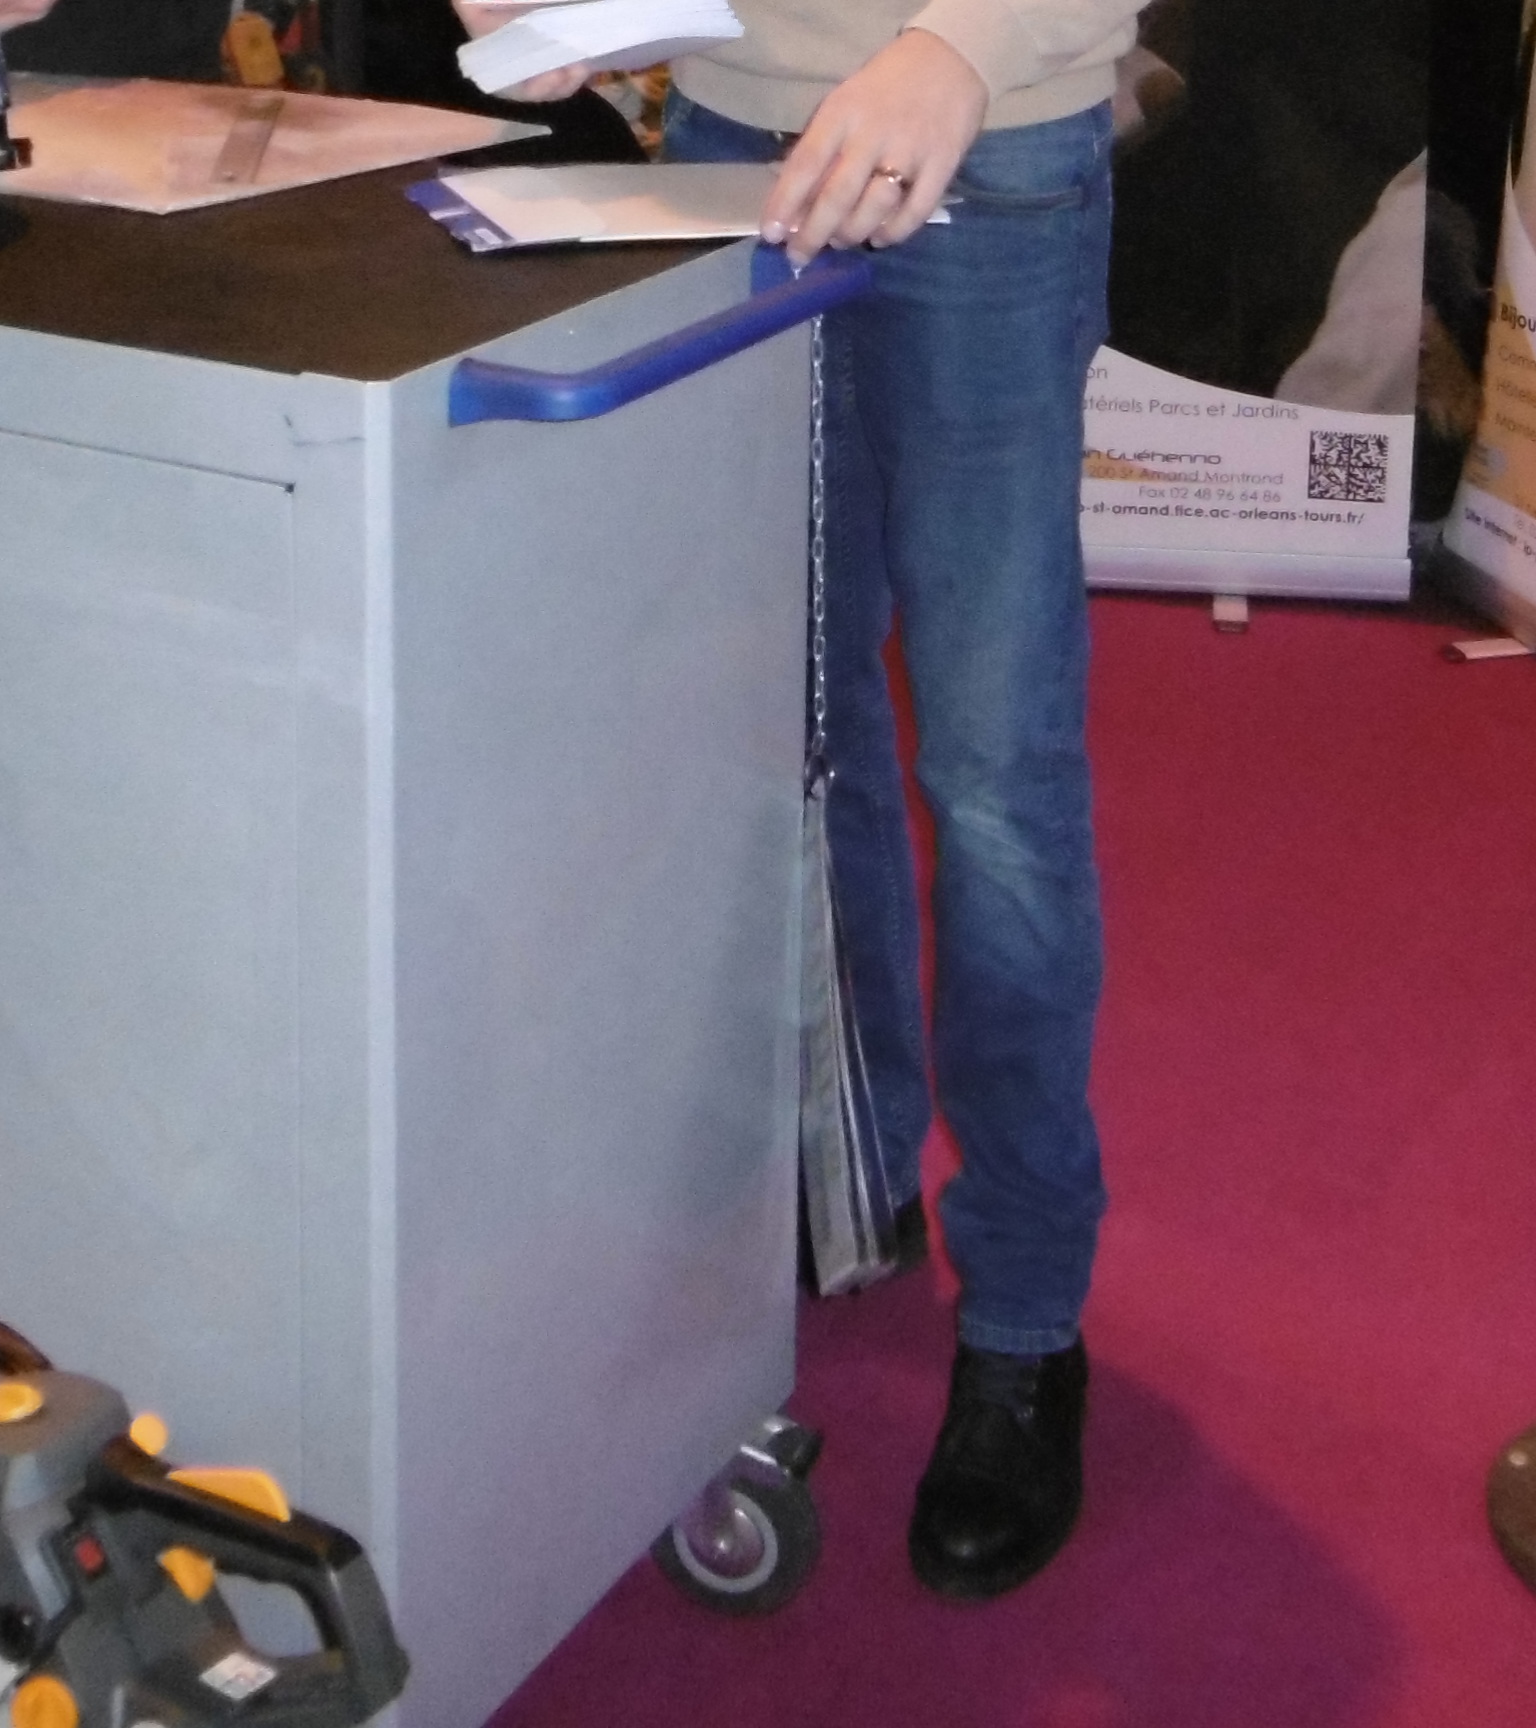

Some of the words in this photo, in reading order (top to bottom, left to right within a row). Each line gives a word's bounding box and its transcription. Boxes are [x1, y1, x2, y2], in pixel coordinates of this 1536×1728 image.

[1148, 398, 1202, 417] Parcs
[1206, 401, 1226, 418] et
[1231, 402, 1300, 421] Jardins
[1138, 485, 1166, 499] Fax
[1170, 486, 1190, 500] 02
